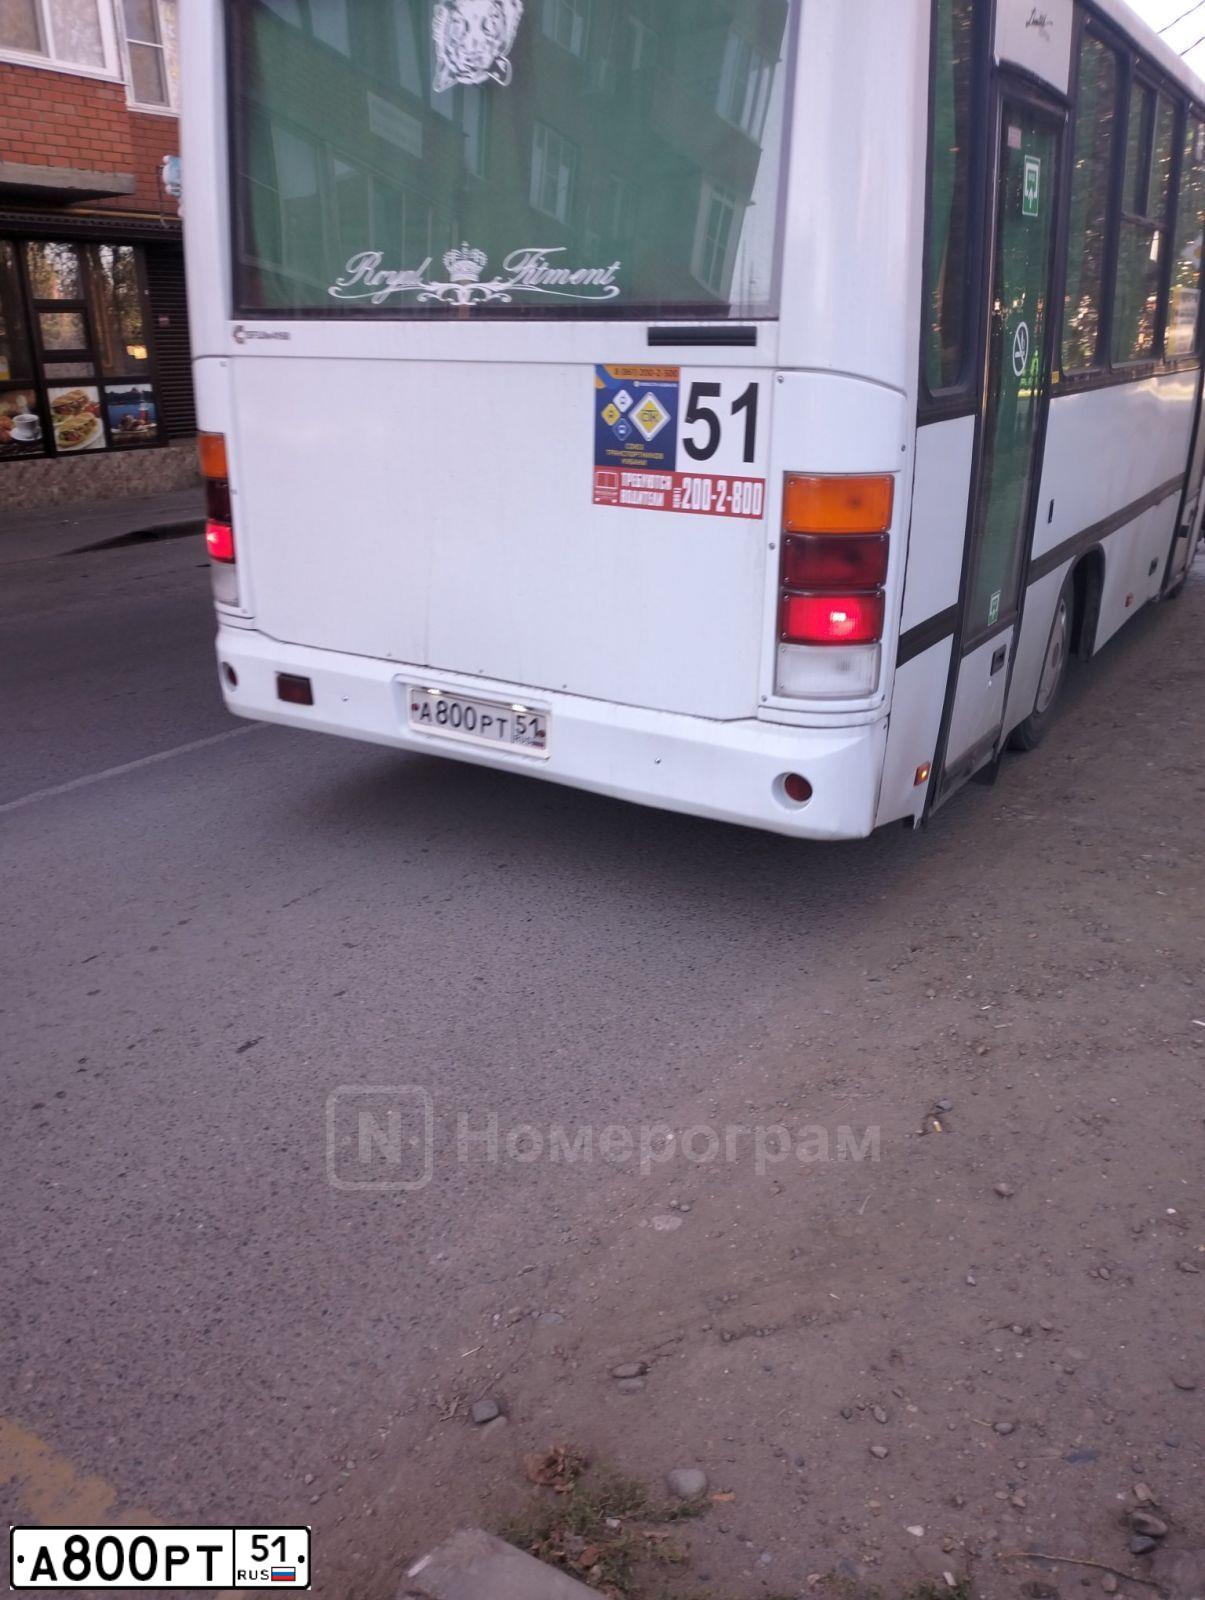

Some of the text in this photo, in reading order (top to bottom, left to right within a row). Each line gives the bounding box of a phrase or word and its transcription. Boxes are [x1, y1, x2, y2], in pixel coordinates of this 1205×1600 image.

[335, 251, 433, 304] Royal
[682, 381, 759, 463] 51
[681, 477, 764, 516] 200-2-800
[420, 700, 539, 738] А800РТ 51
